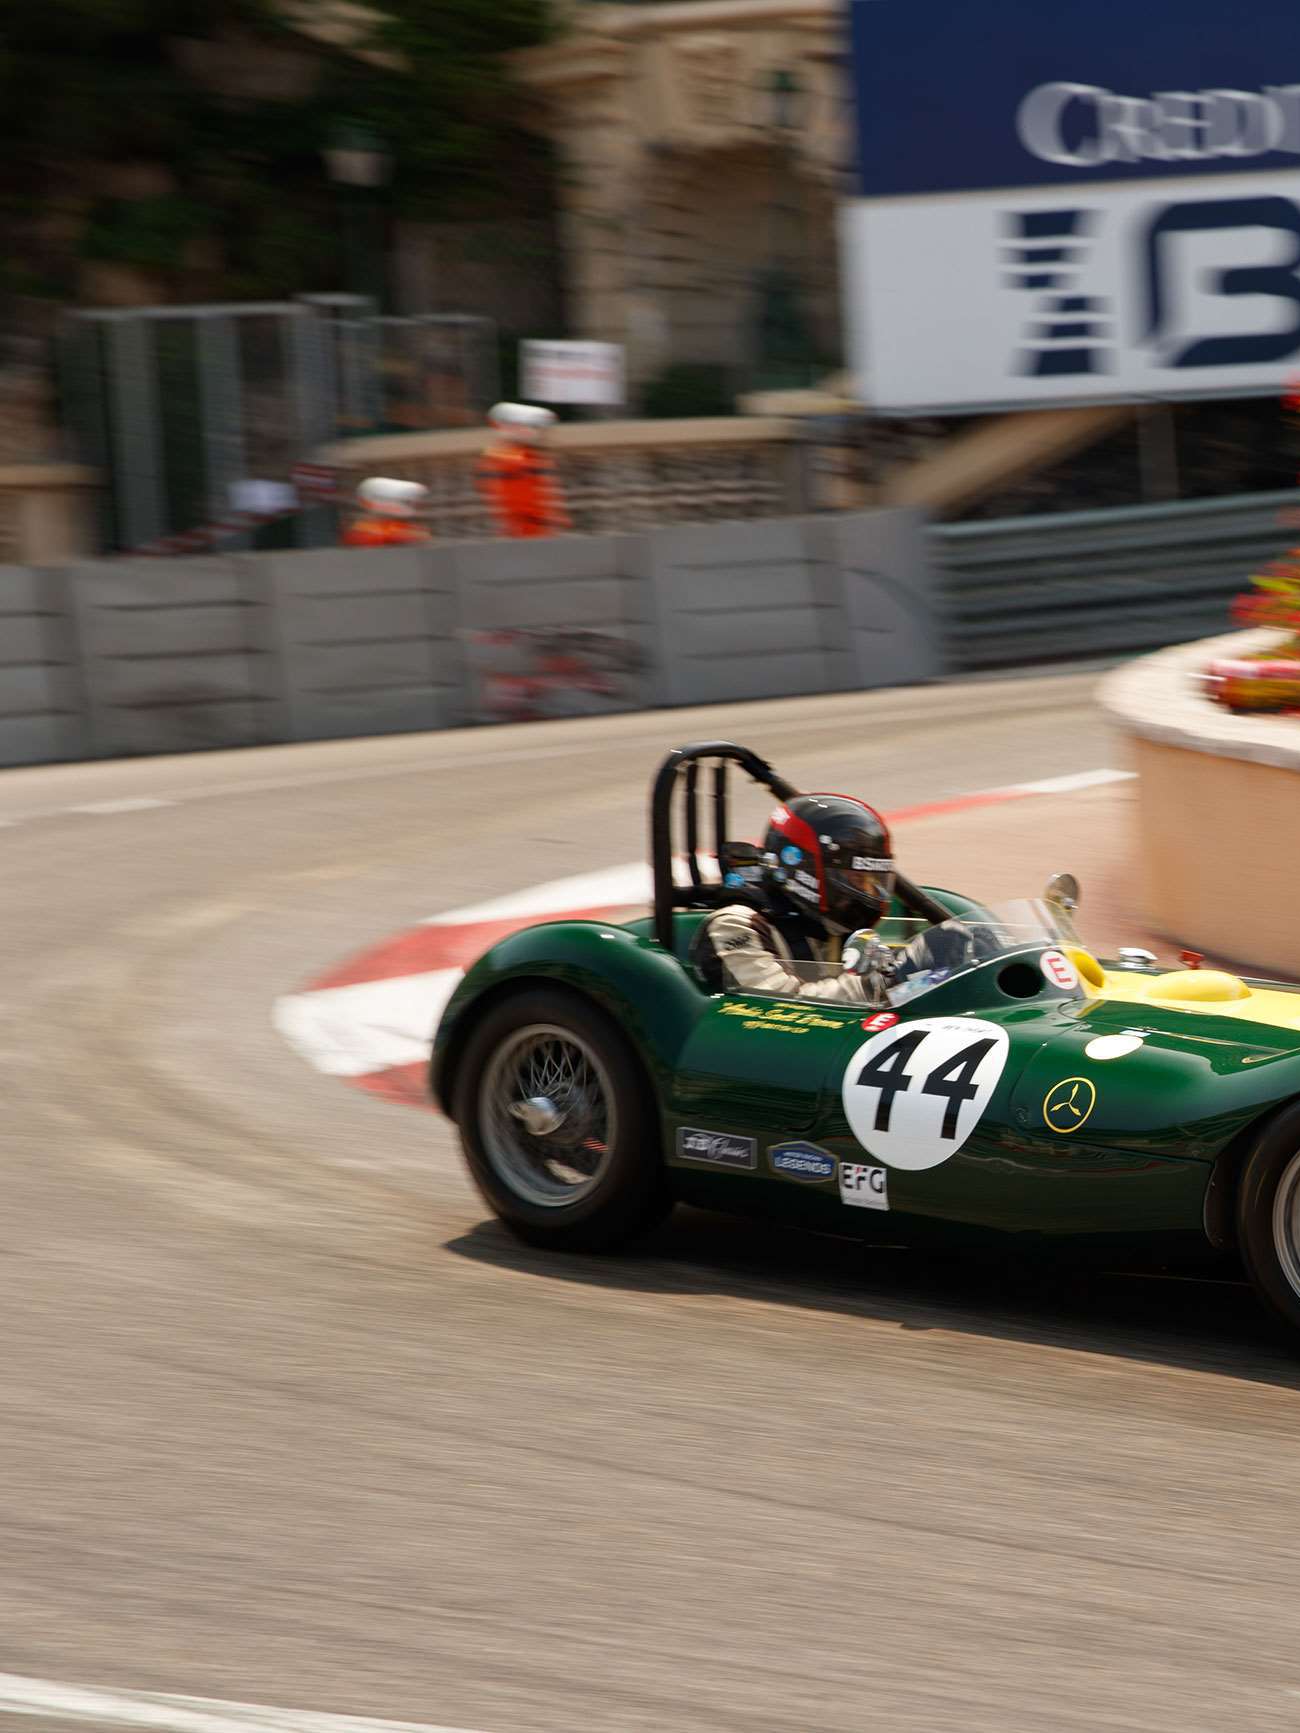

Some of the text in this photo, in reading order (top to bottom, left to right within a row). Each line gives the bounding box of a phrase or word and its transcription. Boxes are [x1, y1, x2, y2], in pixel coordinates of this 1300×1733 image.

[1046, 957, 1072, 983] E
[856, 1029, 999, 1140] 44
[773, 1155, 832, 1175] LEGENDS
[842, 1164, 885, 1194] EFG
